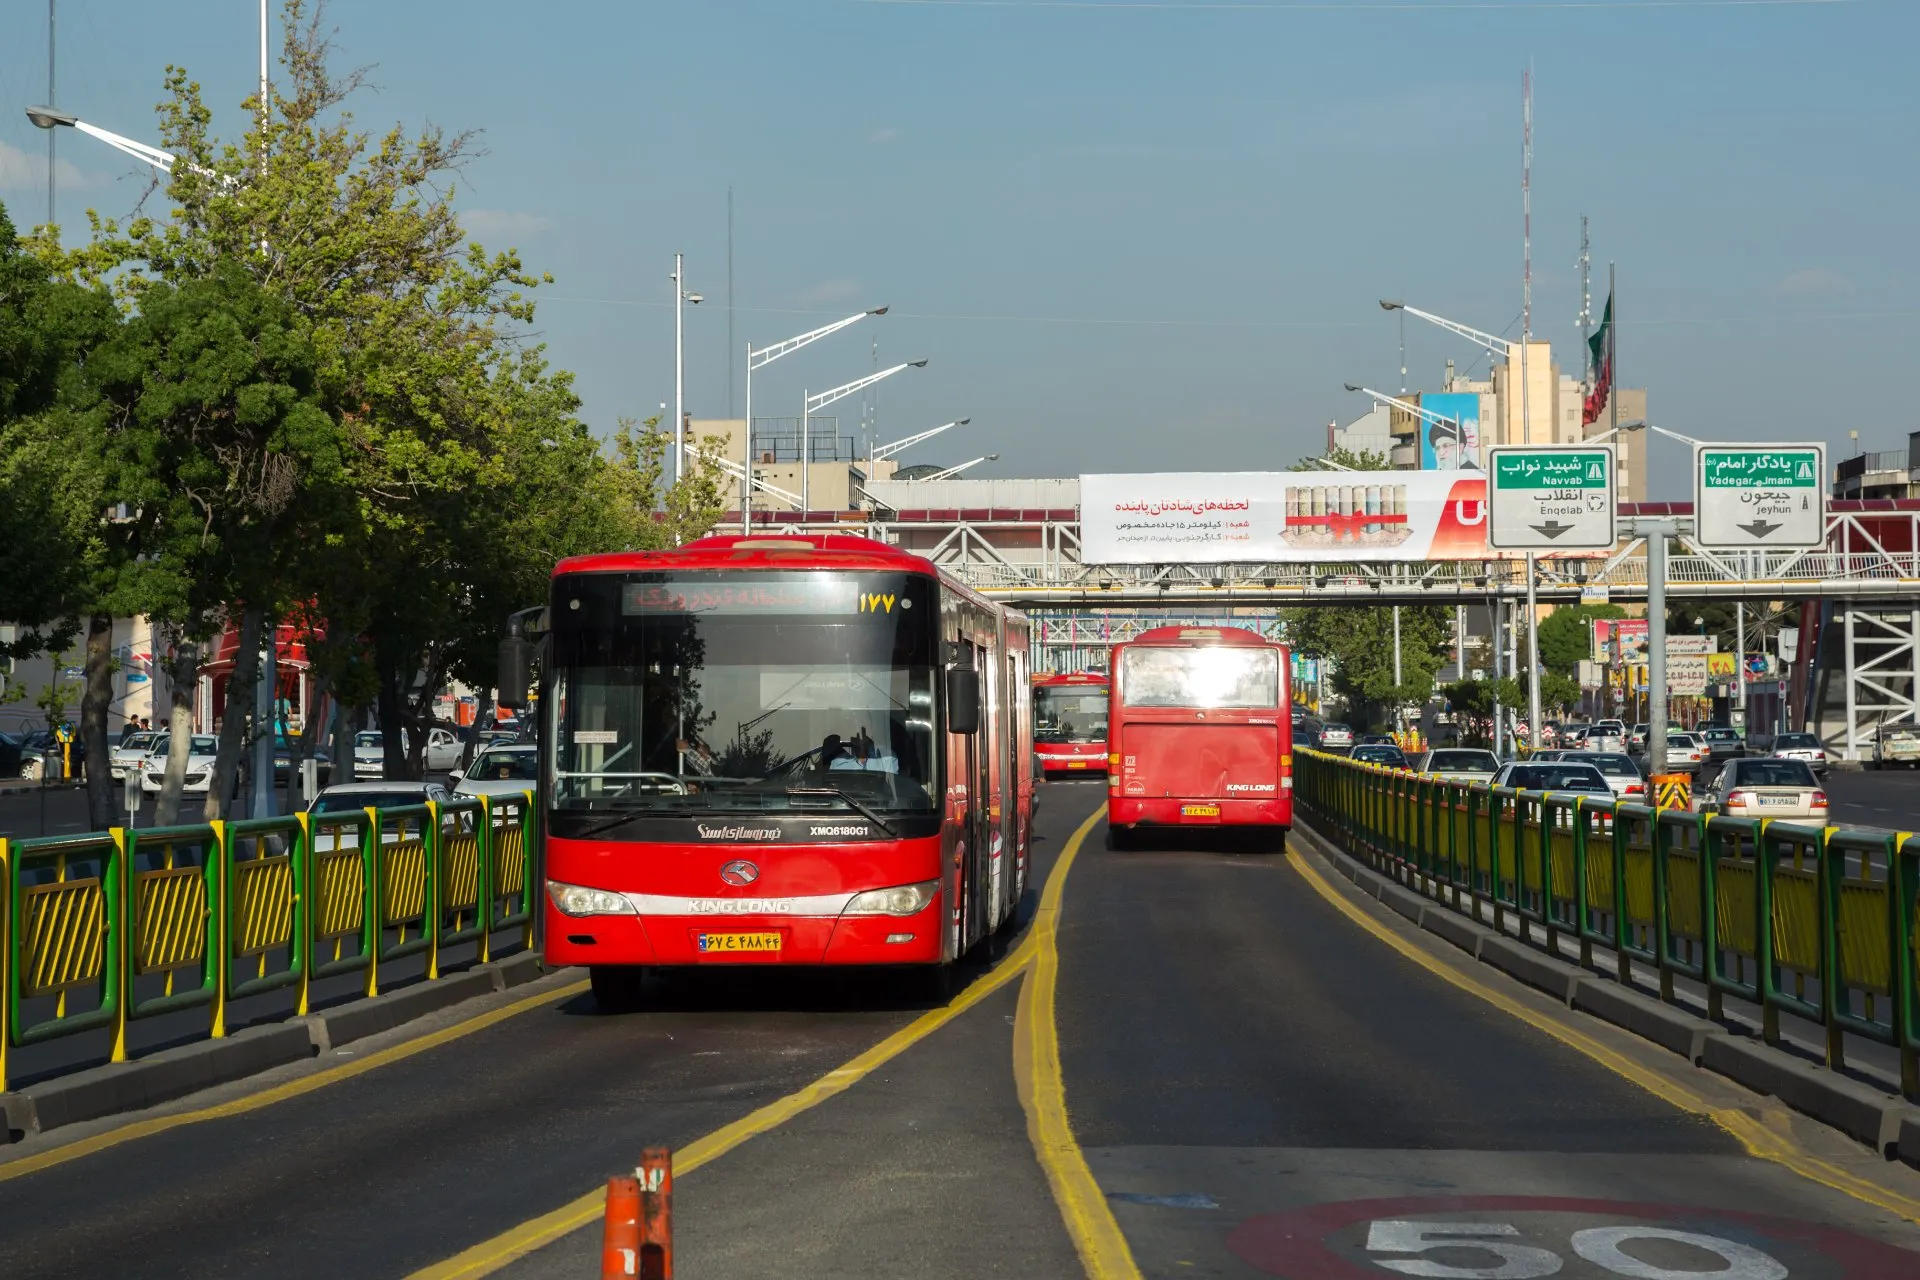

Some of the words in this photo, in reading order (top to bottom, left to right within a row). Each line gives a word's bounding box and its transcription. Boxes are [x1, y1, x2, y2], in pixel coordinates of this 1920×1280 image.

[1501, 459, 1540, 477] نواب
[1544, 456, 1582, 474] شهید
[1716, 456, 1746, 476] امام
[1747, 455, 1792, 474] یادگار
[1542, 476, 1583, 485] Navvab
[1533, 489, 1583, 505] انقلاب
[1740, 492, 1791, 506] جیحون
[1115, 499, 1150, 516] پاینده
[1540, 506, 1583, 516] Enqelab
[1186, 521, 1222, 530] کیلومتر
[859, 592, 895, 614] ۱۷۷
[810, 826, 869, 836] XMQ6180G1
[687, 900, 734, 912] KING
[736, 900, 791, 912] LONG
[1366, 1219, 1790, 1280] 50
